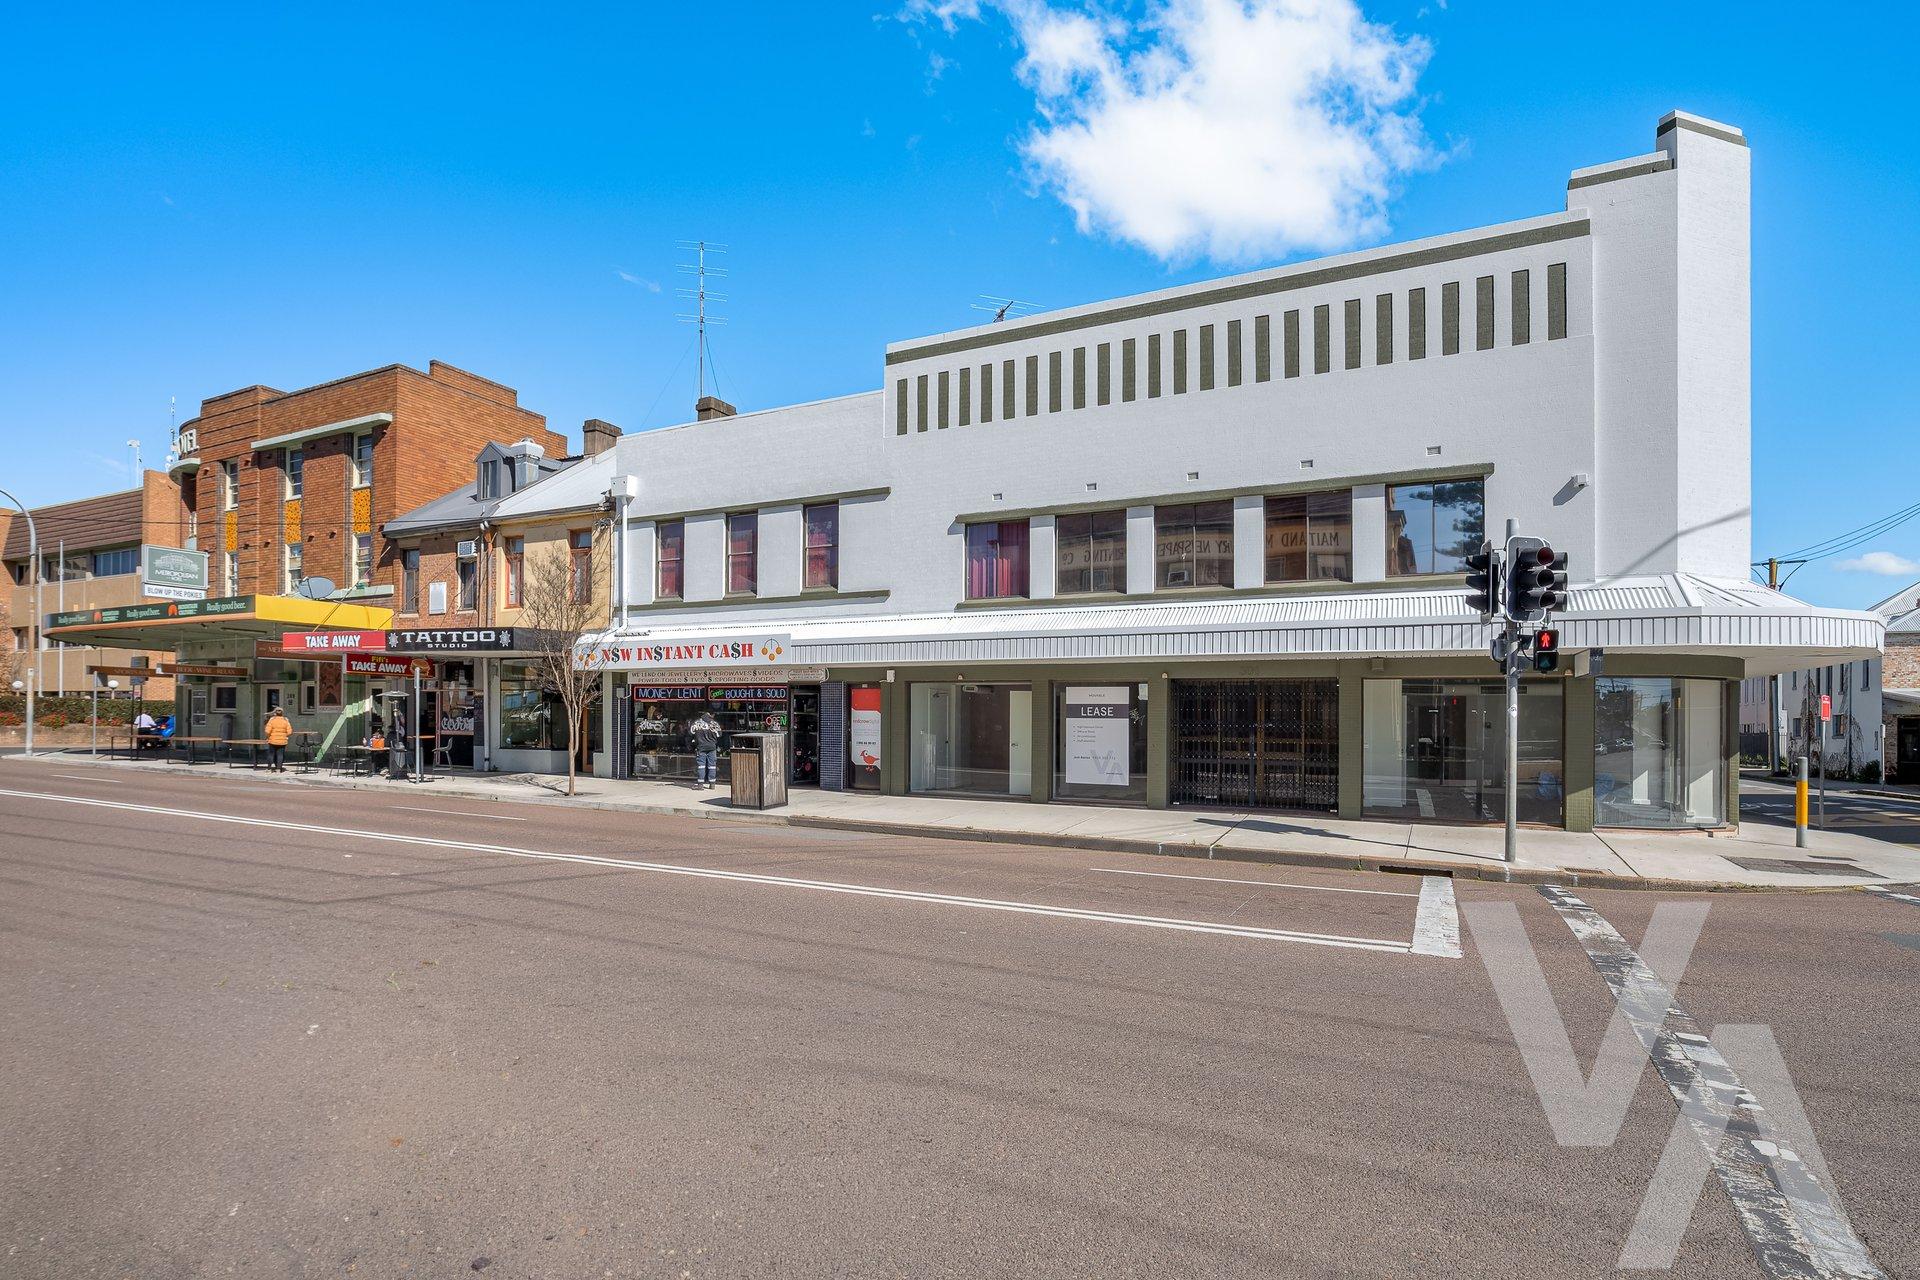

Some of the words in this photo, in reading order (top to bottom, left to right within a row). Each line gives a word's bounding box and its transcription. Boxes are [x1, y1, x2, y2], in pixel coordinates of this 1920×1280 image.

[155, 569, 199, 579] METROPOLITAN
[184, 590, 203, 598] POKIES
[206, 602, 222, 612] Really
[222, 601, 234, 611] good
[305, 635, 329, 648] TAKE
[332, 635, 361, 648] AWAY
[401, 631, 496, 643] TATTOO
[351, 661, 377, 671] TAKE
[378, 664, 407, 674] AWAY
[638, 688, 673, 699] MONEY
[677, 688, 702, 699] LENT
[725, 688, 754, 699] BOUGHT
[756, 688, 762, 698] &
[766, 688, 786, 699] SOLD
[1081, 706, 1114, 717] LEASE
[765, 714, 788, 726] OPEN
